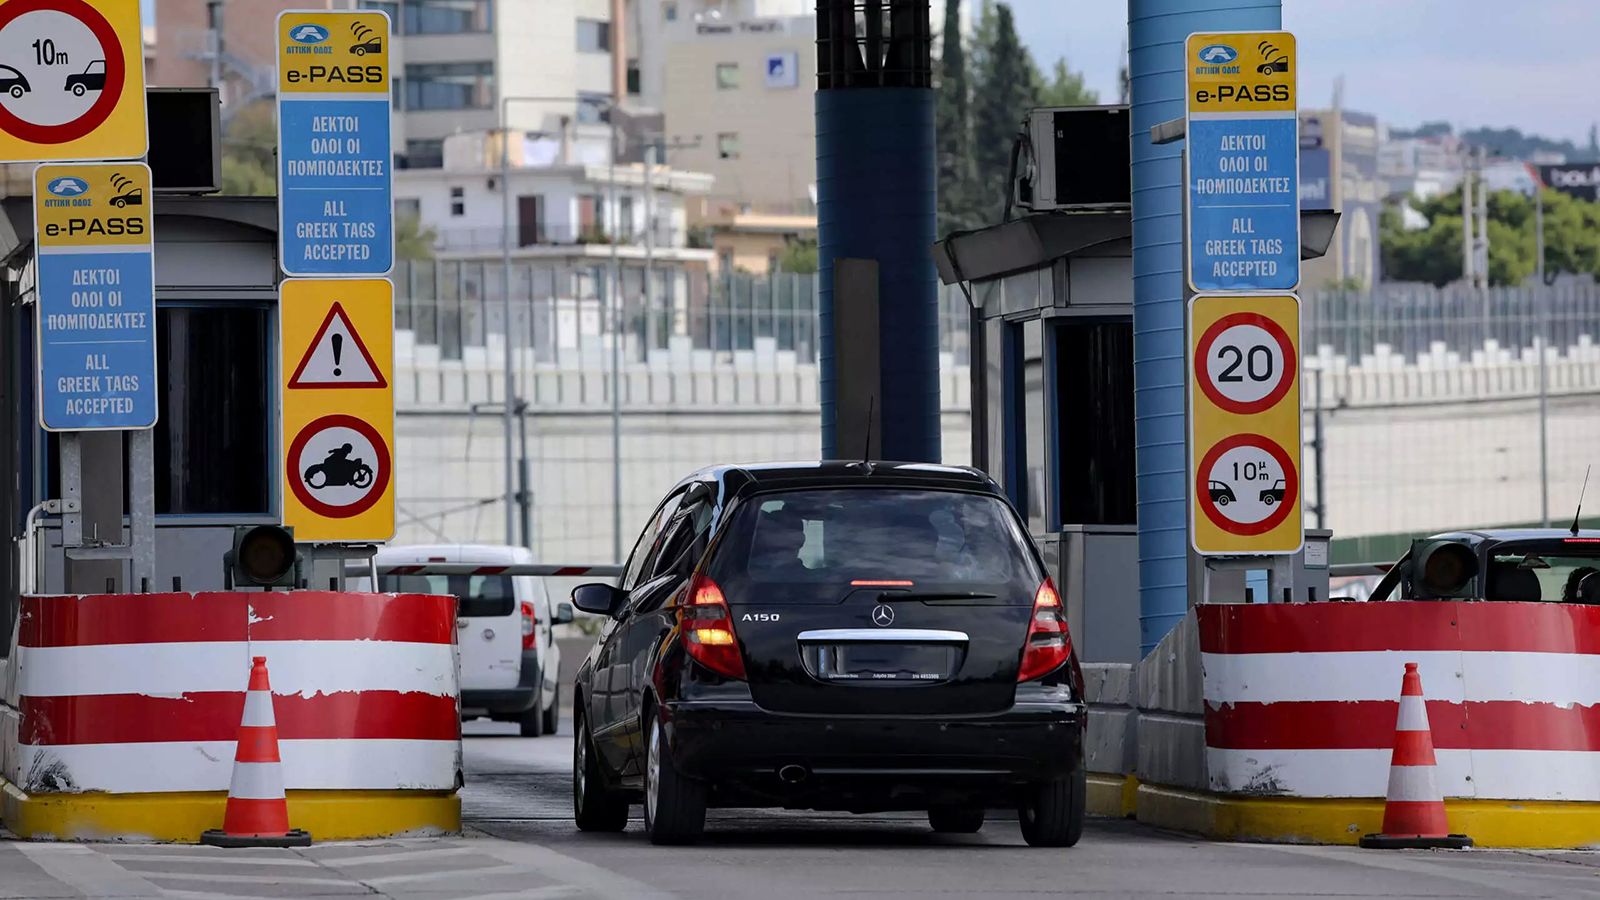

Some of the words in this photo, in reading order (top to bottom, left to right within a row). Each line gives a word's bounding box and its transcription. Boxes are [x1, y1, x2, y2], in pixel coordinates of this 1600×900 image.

[287, 66, 382, 83] e-PASS
[1196, 85, 1289, 103] e-PASS
[313, 117, 358, 132] ΔΕΚΤΟΙ
[312, 139, 341, 154] ΟΛΟΙ
[347, 139, 359, 154] ΟΙ
[1221, 135, 1265, 150] ΔΕΚΤΟΙ
[288, 160, 383, 176] ΠΟΜΠΟΔΕΚΤΕΣ
[1220, 157, 1250, 173] ΟΛΟΙ
[1254, 157, 1268, 172] ΟΙ
[1197, 178, 1291, 194] ΠΟΜΠΟΔΕΚΤΕΣ
[324, 201, 347, 216] ALL
[46, 218, 143, 236] e-PASS
[297, 223, 337, 238] GREEK
[343, 223, 375, 238] TAGS
[1232, 218, 1254, 233] ALL
[304, 244, 369, 260] ACCEPTED
[1206, 240, 1246, 255] GREEK
[1250, 239, 1282, 254] TAGS
[1213, 261, 1276, 276] ACCEPTED
[73, 269, 119, 285] ΔΕΚΤΟΙ
[72, 292, 102, 307] ΟΛΟΙ
[109, 291, 121, 306] ΟΙ
[48, 313, 146, 330] ΠΟΜΠΟΔΕΚΤΕΣ
[86, 355, 109, 370] ALL
[1218, 345, 1273, 382] 20
[58, 376, 100, 392] GREEK
[105, 376, 139, 391] TAGS
[66, 398, 133, 415] ACCEPTED
[741, 613, 780, 622] A150
